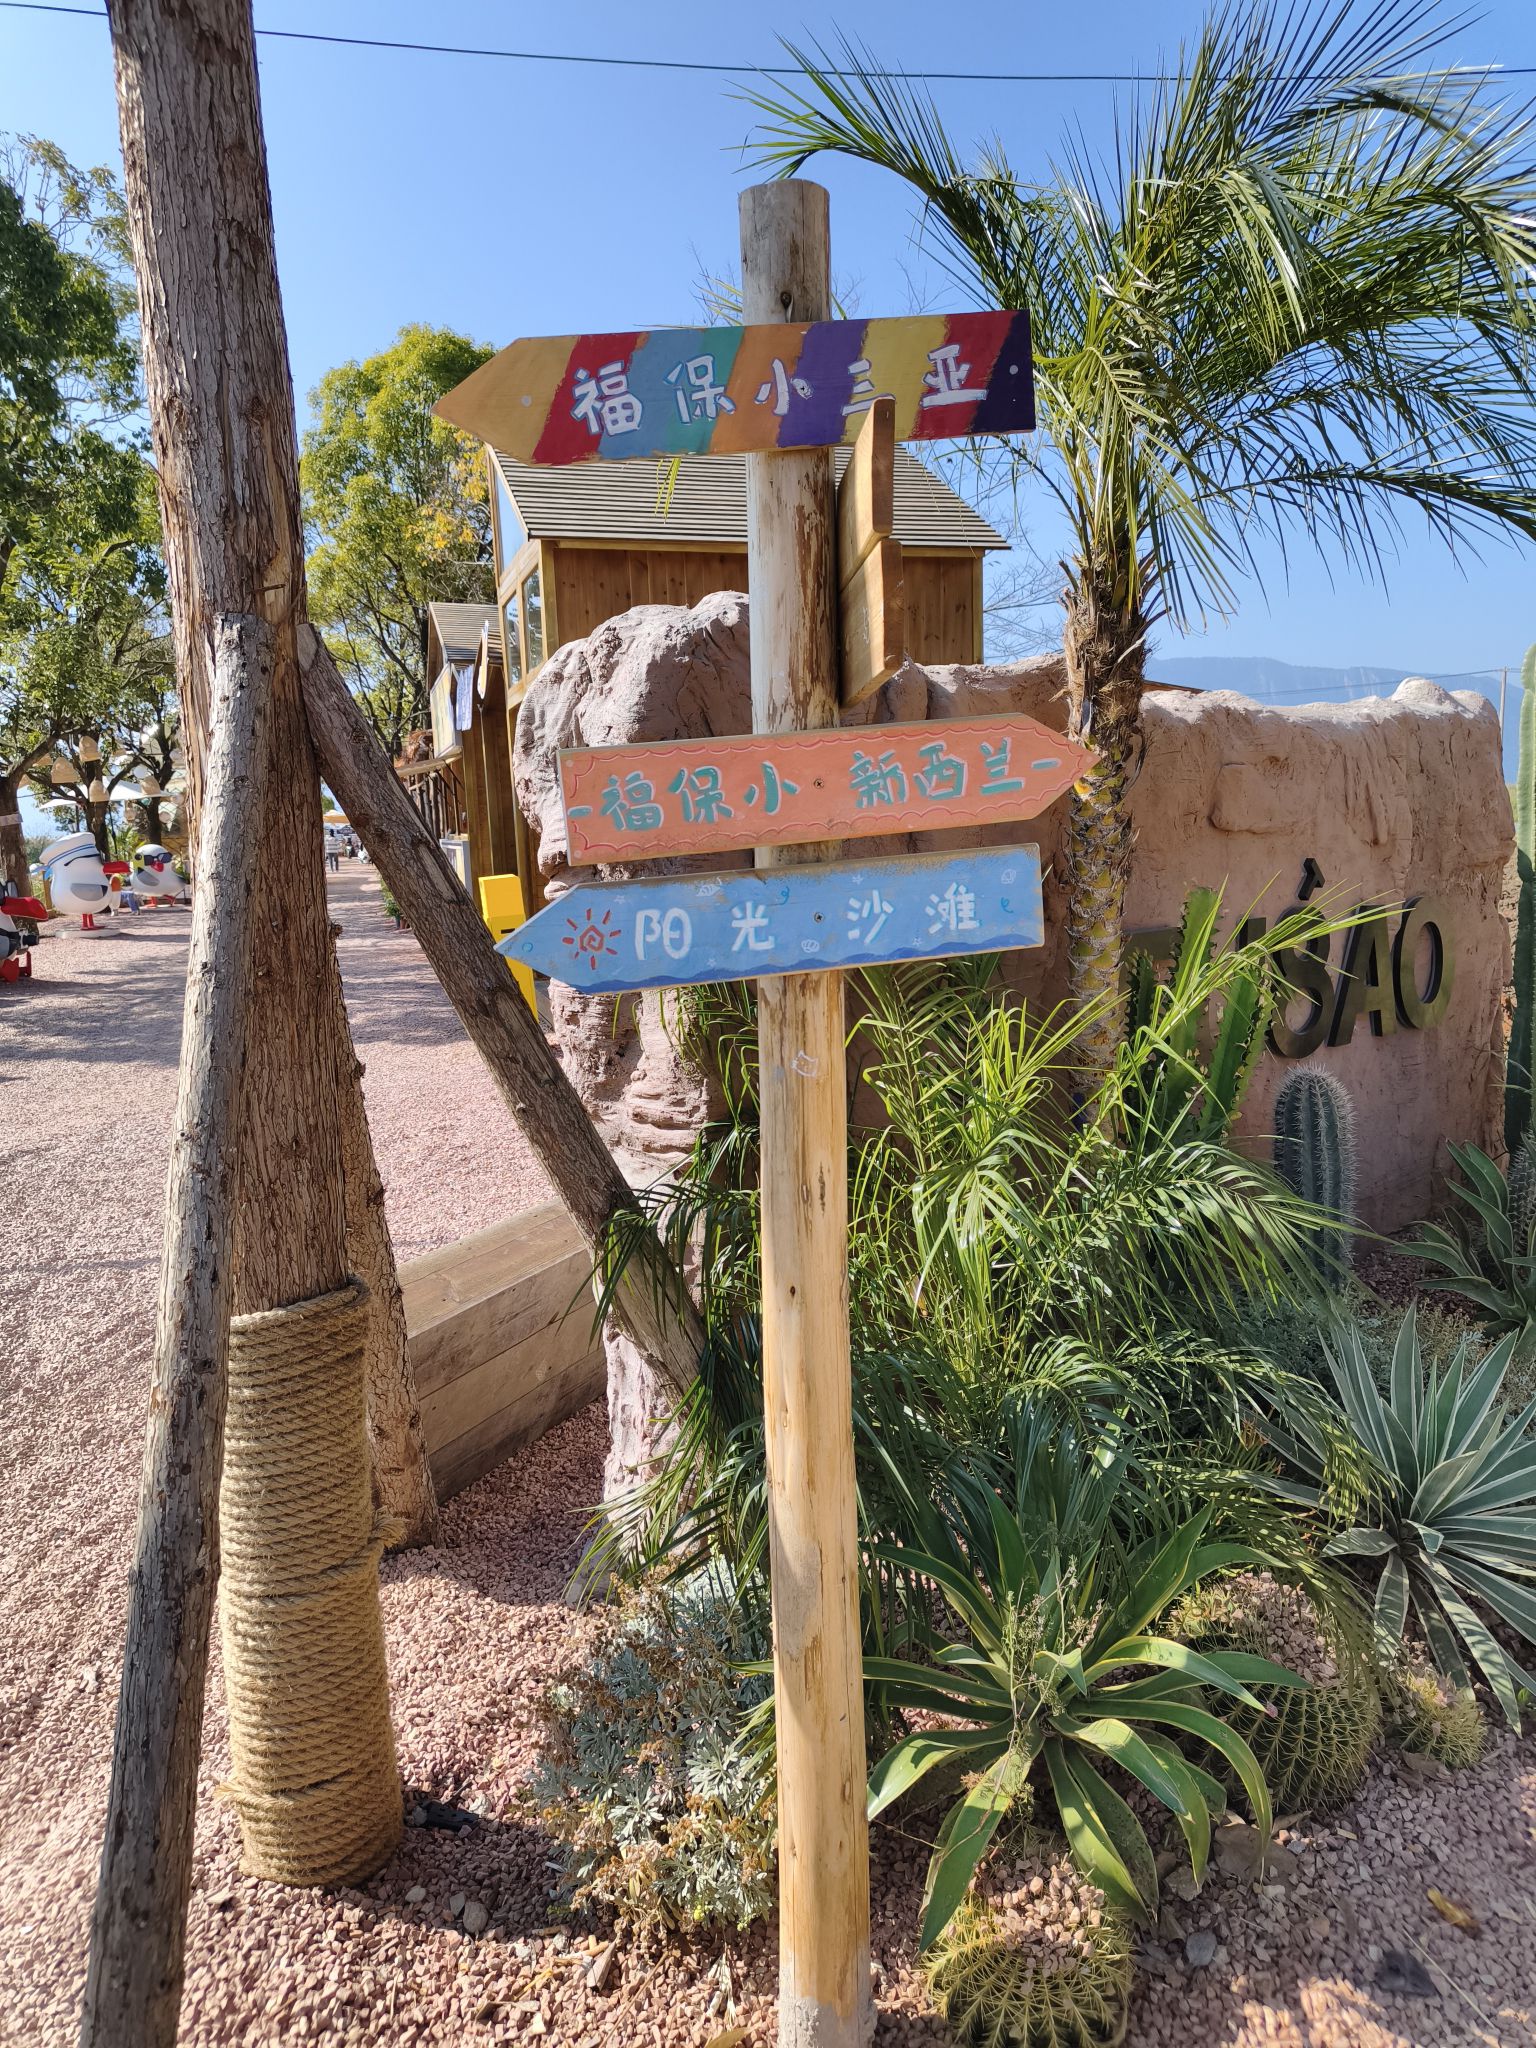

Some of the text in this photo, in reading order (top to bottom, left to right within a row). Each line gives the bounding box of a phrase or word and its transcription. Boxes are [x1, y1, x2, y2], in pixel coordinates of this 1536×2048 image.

[571, 344, 987, 436] 福保小三亚
[634, 882, 981, 961] 阳光沙滩
